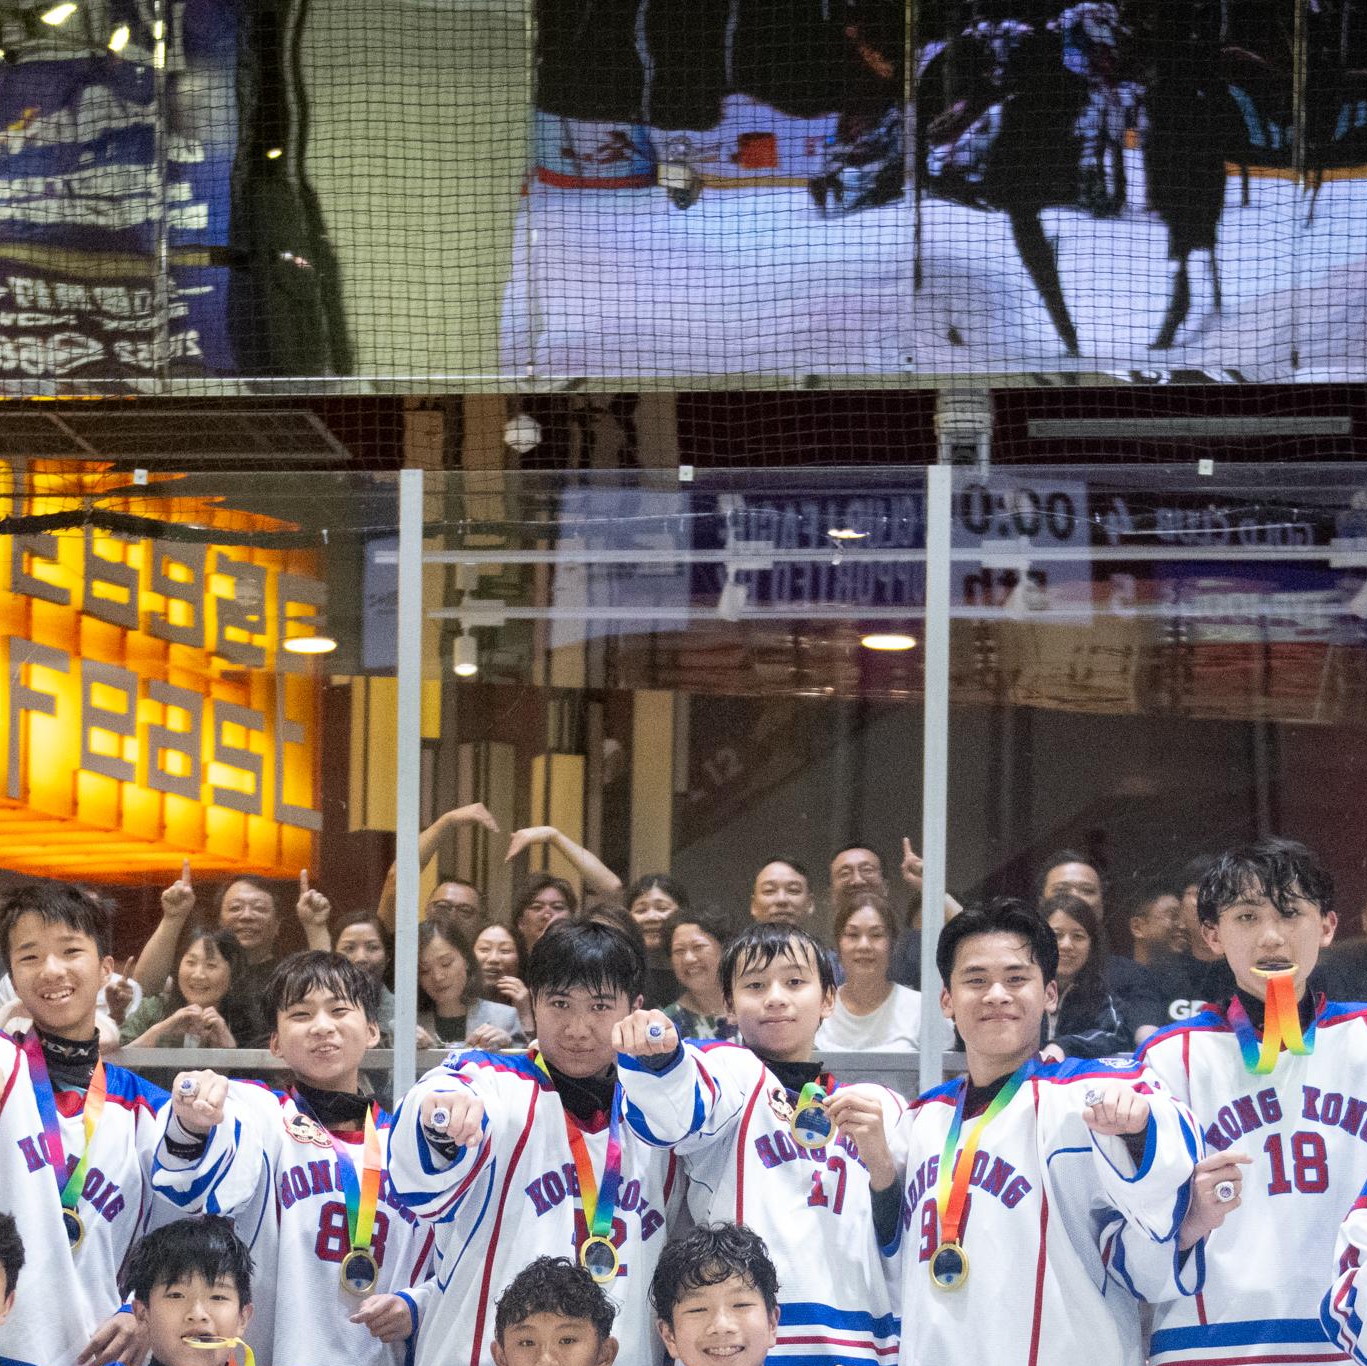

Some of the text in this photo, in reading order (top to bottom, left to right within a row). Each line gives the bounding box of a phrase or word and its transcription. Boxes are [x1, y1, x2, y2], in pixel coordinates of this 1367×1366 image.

[1205, 1086, 1284, 1152] HONG
[807, 1154, 848, 1216] 17
[1263, 1130, 1331, 1197] 18
